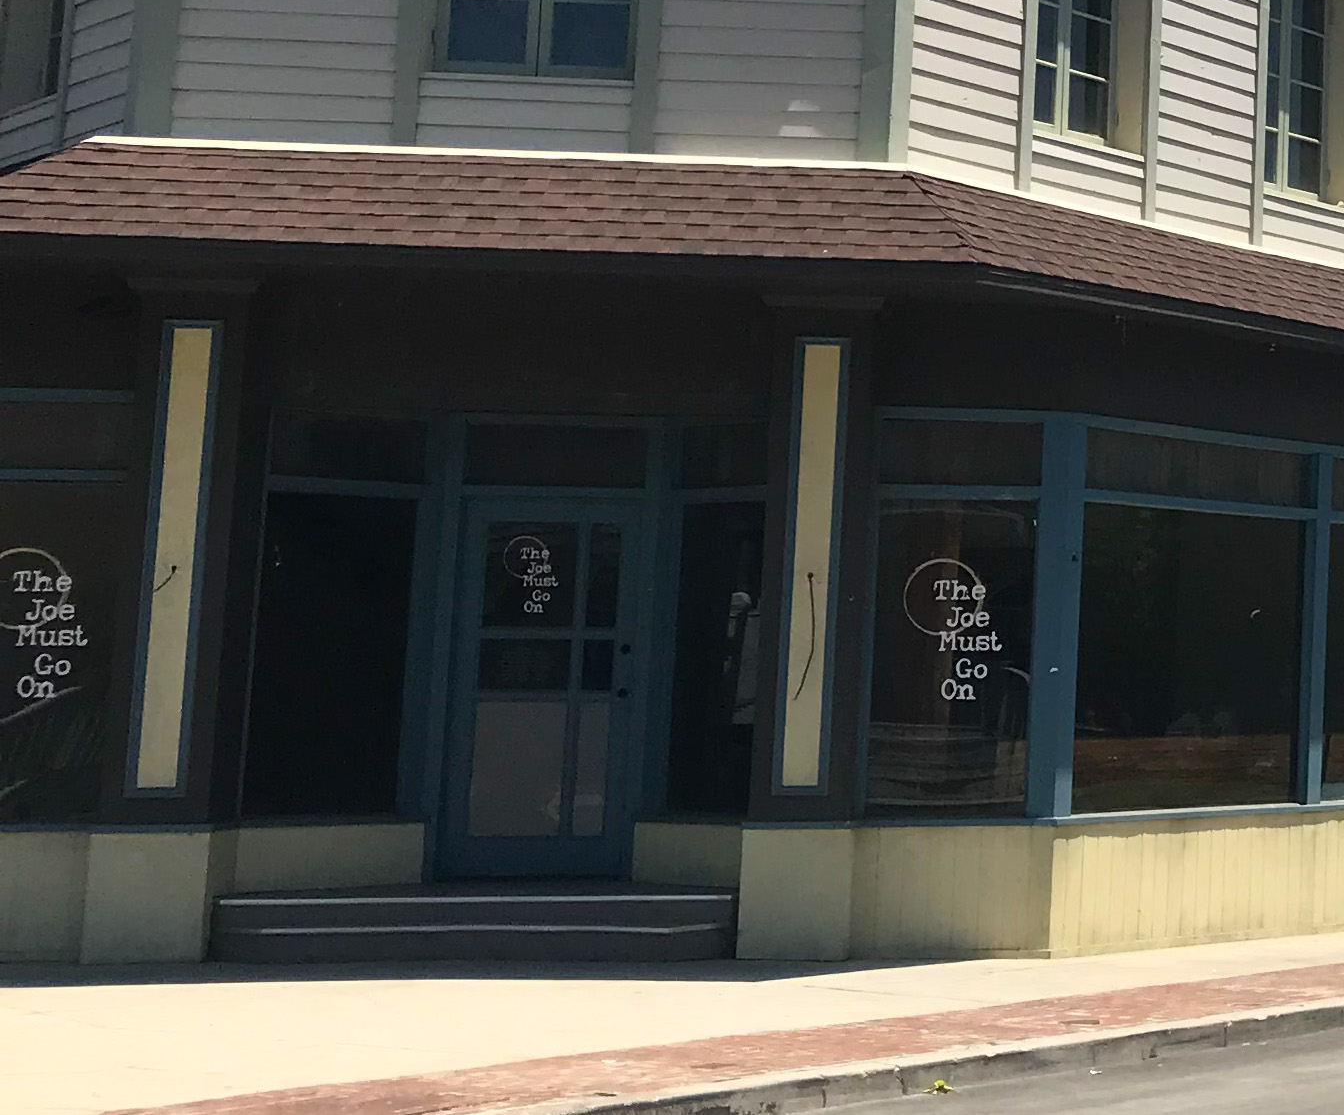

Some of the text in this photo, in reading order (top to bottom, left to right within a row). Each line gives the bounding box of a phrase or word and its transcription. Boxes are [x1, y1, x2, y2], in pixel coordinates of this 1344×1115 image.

[520, 547, 550, 559] The
[527, 562, 552, 573] Joe
[12, 570, 72, 592] The
[523, 575, 559, 587] Must
[933, 580, 986, 601] The
[532, 590, 551, 601] Go
[25, 599, 75, 621] Joe
[523, 600, 544, 613] On
[946, 607, 990, 627] Joe
[15, 625, 88, 646] Must
[938, 631, 1002, 651] Must
[34, 653, 72, 675] Go
[955, 658, 988, 679] Go
[16, 675, 55, 698] On
[941, 679, 976, 700] On
